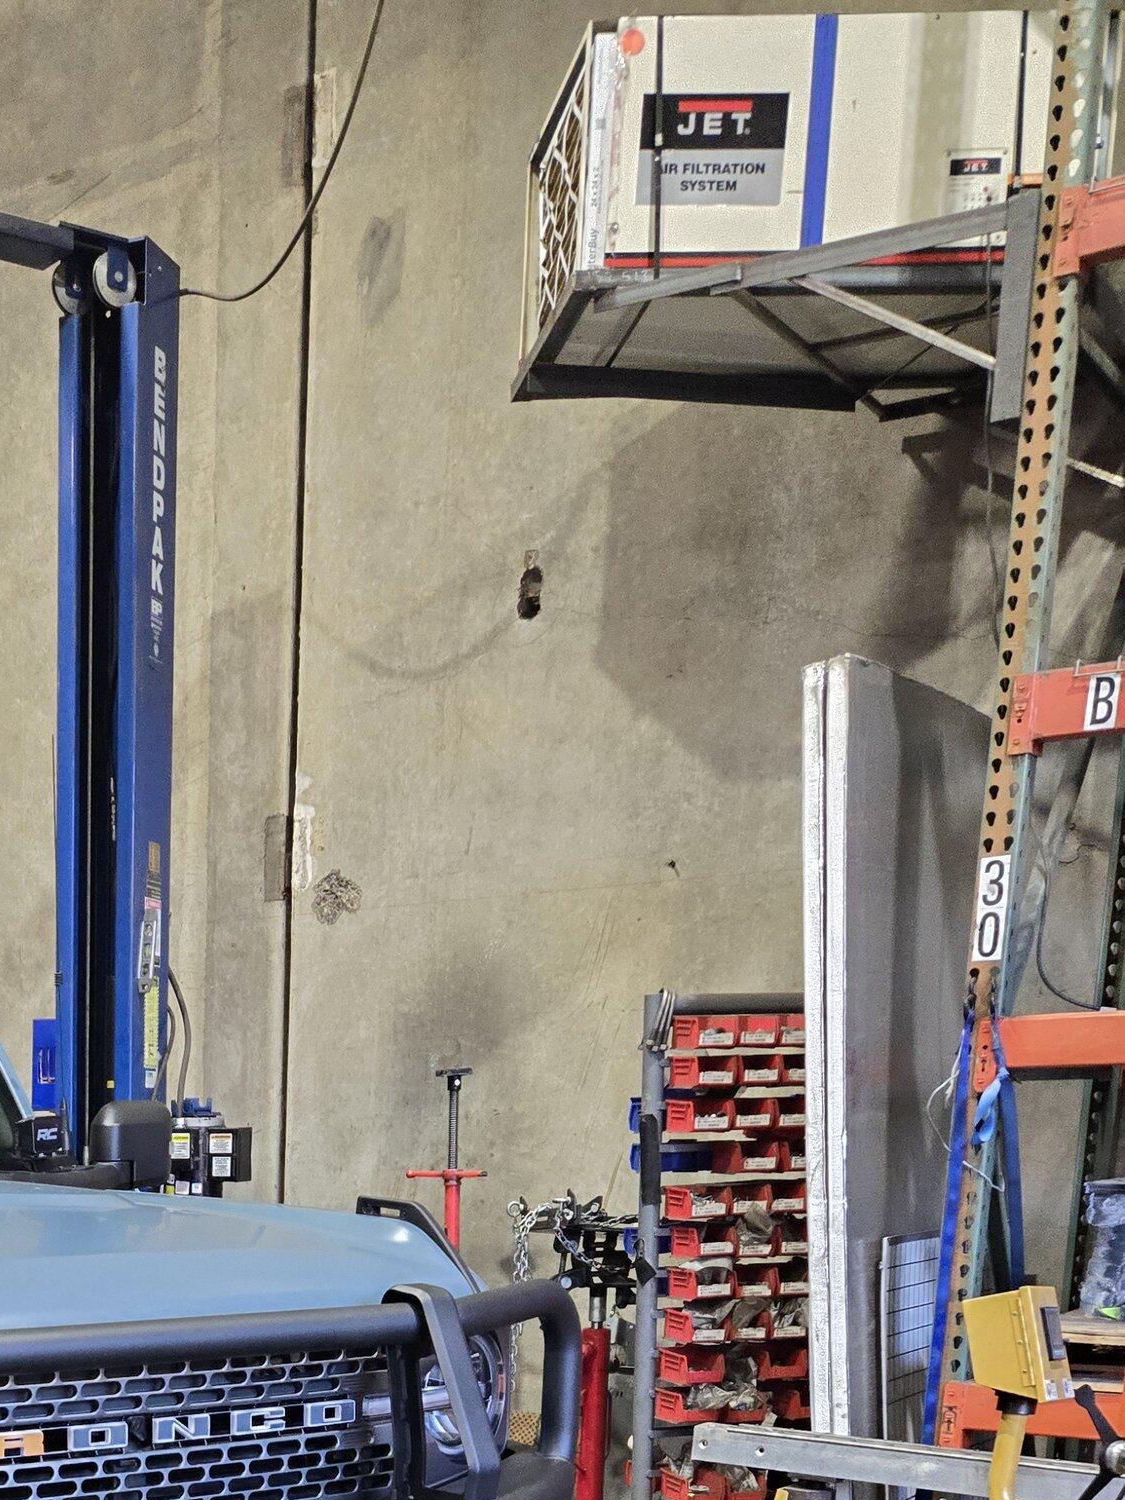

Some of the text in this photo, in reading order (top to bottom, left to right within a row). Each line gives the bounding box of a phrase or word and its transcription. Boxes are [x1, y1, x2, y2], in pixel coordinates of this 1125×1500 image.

[677, 112, 752, 136] JET
[682, 163, 766, 175] FILTRATION
[963, 162, 989, 173] JET
[679, 180, 737, 192] SYSTEM
[150, 345, 166, 595] BENDPAK
[1090, 676, 1116, 726] B
[977, 859, 1005, 958] 30
[36, 1127, 58, 1141] RC
